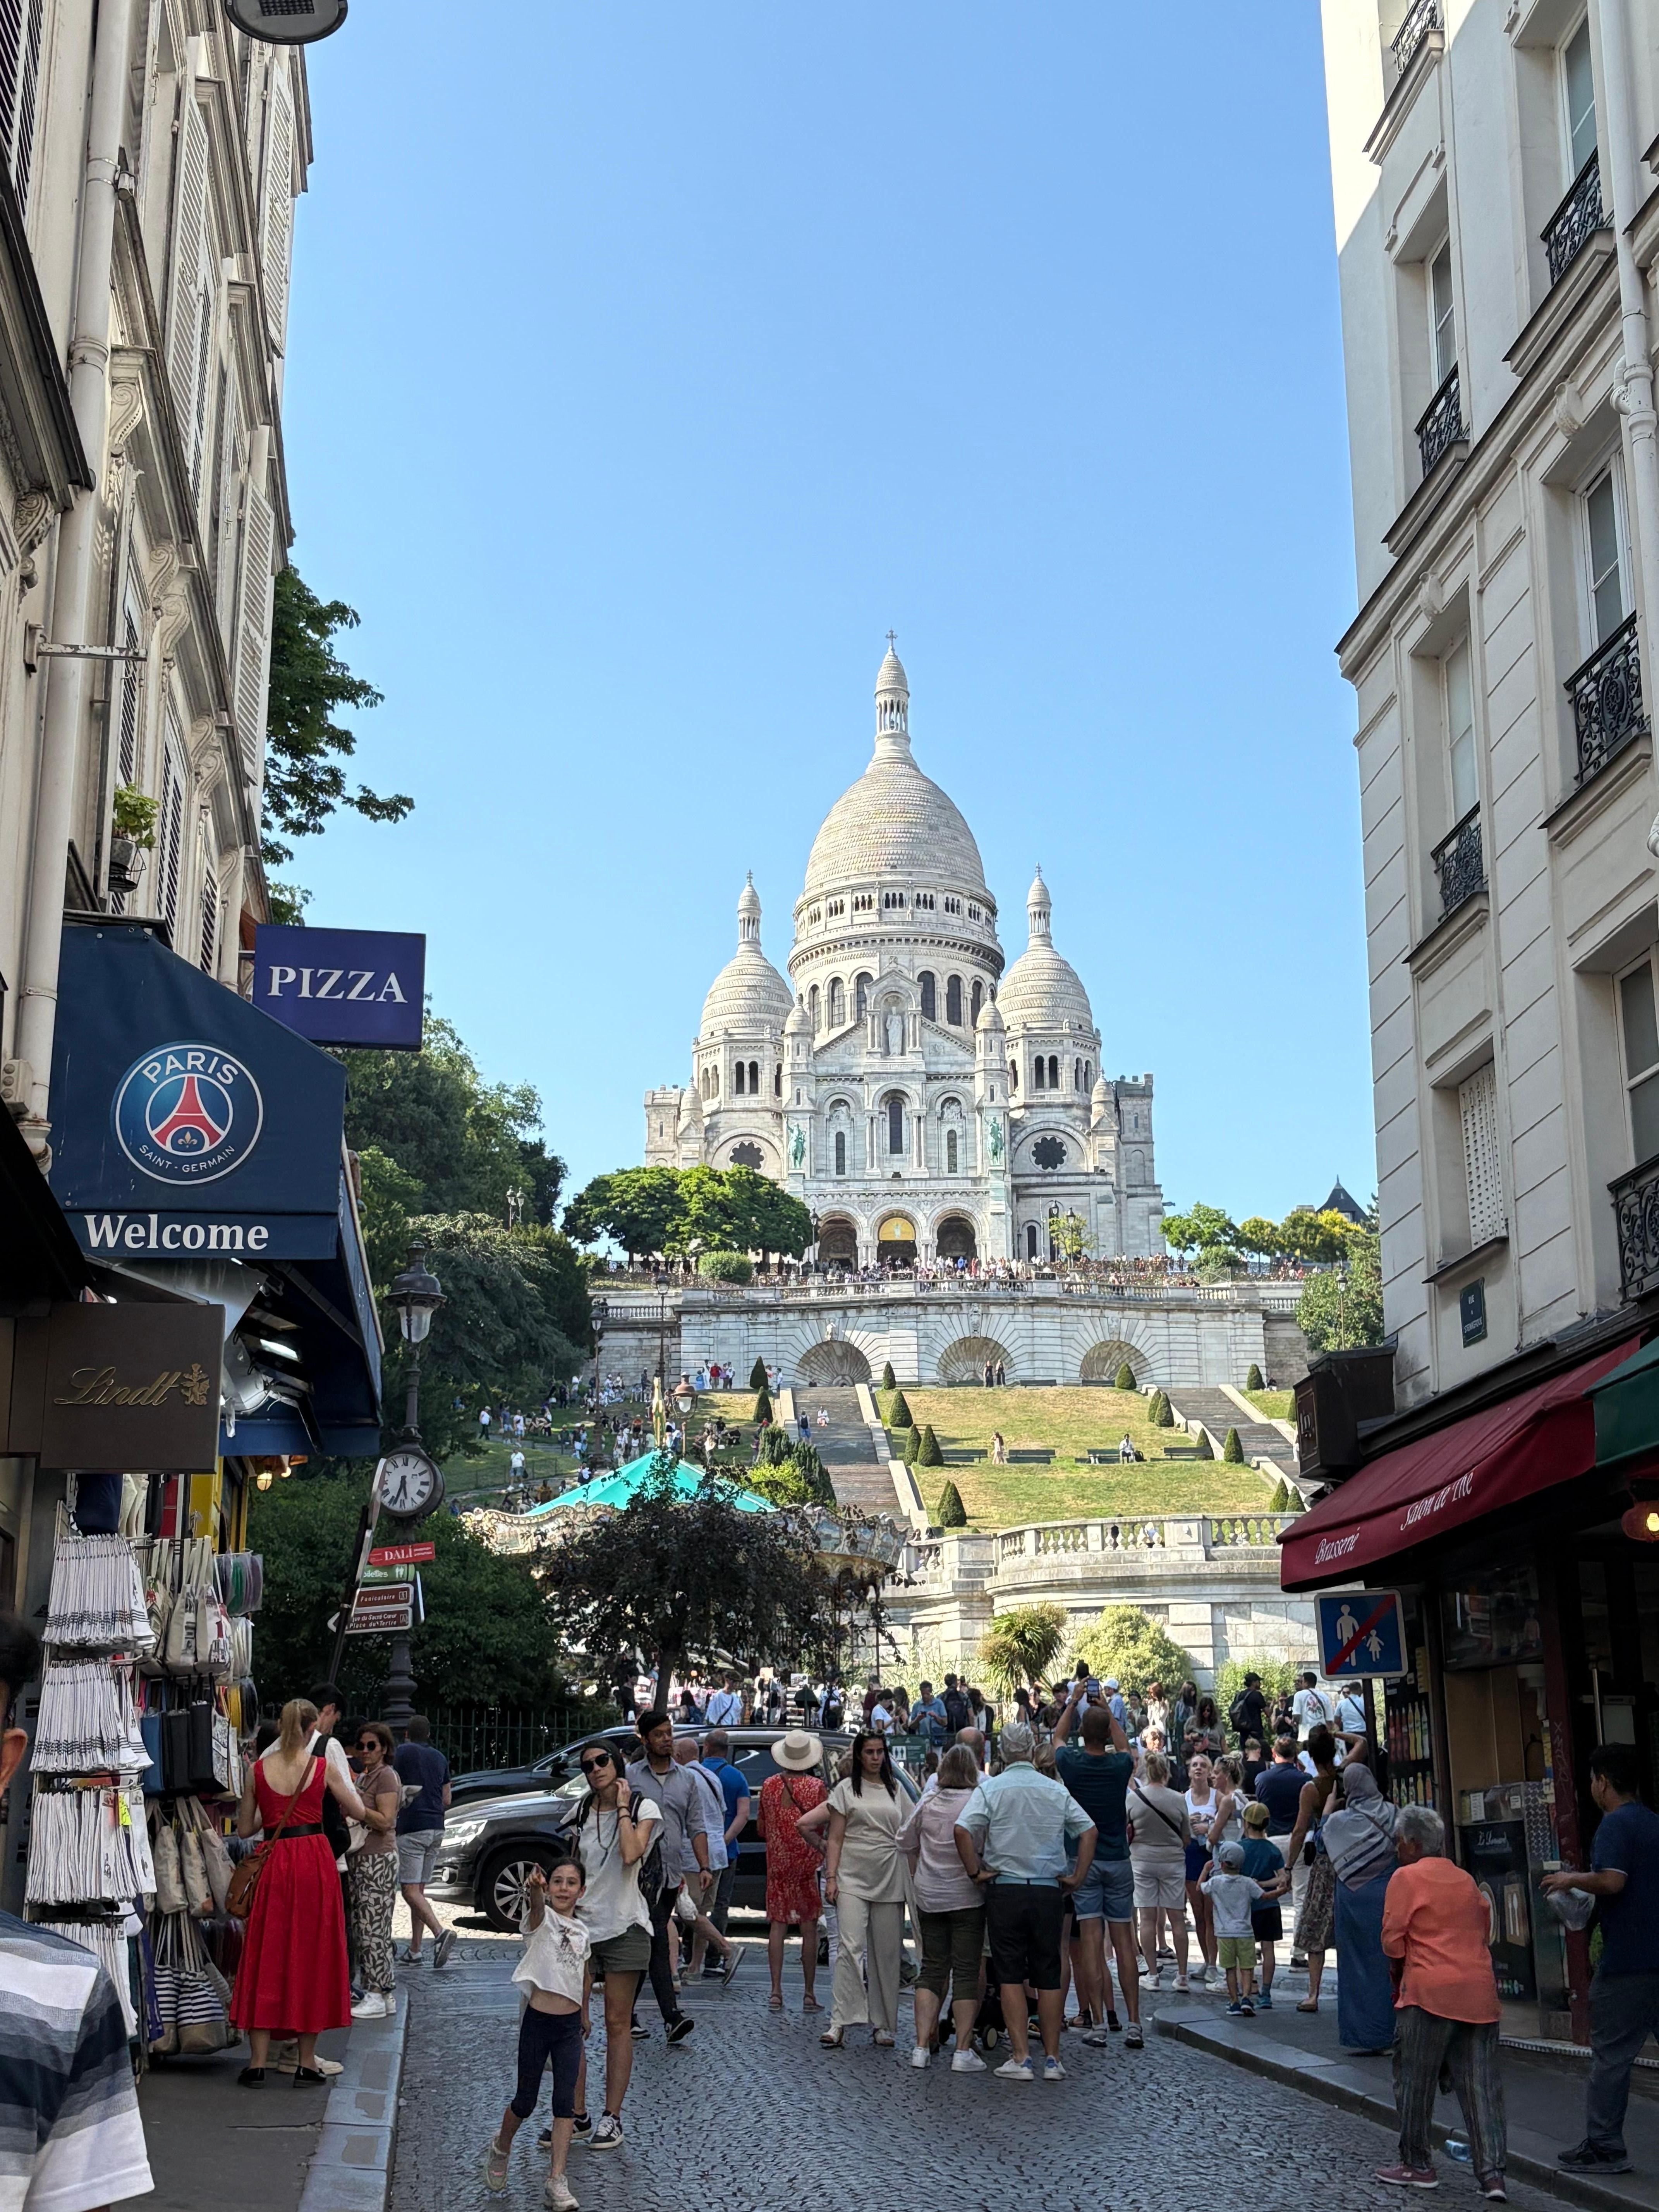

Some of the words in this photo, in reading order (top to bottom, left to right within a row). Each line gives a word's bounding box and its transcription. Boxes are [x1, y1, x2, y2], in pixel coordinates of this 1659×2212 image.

[267, 965, 408, 1003] PIZZA
[142, 1051, 239, 1085] PARIS
[84, 1214, 269, 1250] Welcome
[53, 1366, 182, 1406] Lindt
